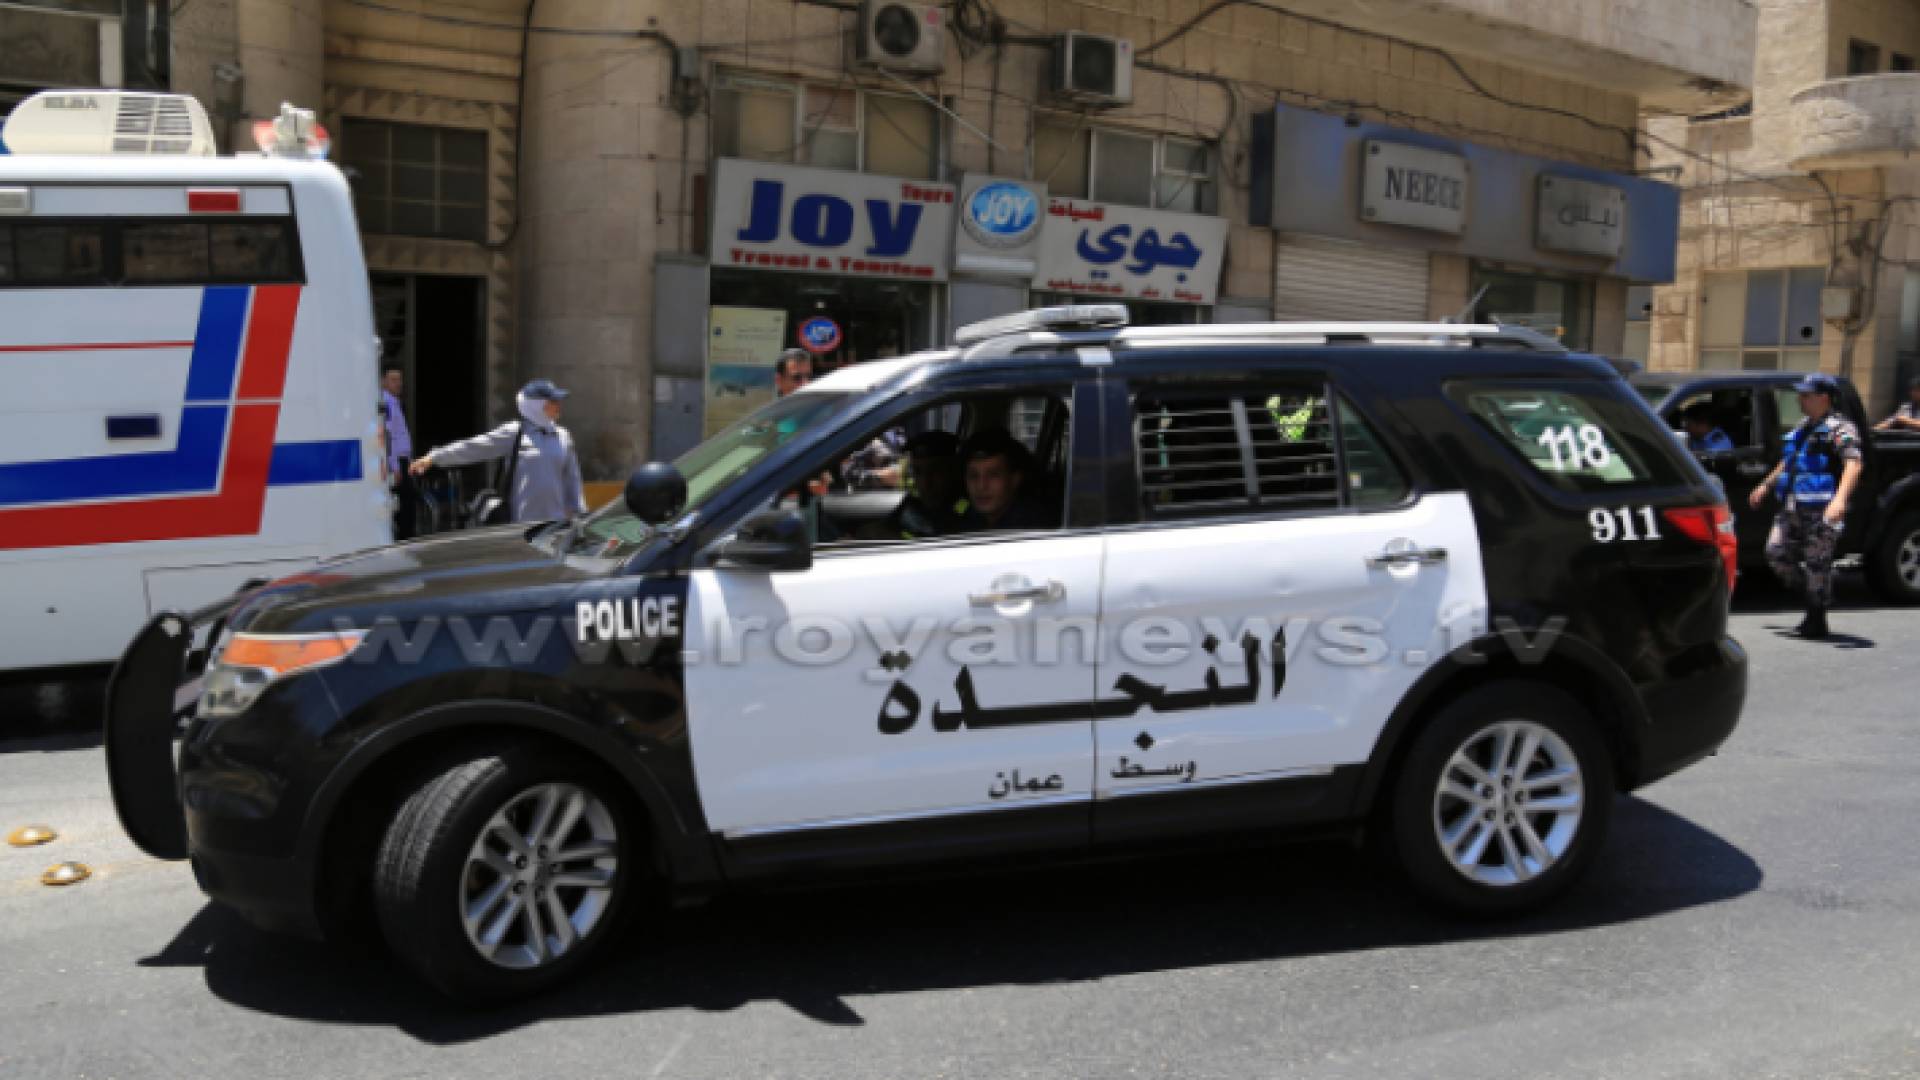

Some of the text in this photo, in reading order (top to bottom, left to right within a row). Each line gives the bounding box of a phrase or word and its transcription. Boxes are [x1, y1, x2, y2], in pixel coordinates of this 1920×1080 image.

[979, 192, 1031, 226] JOY
[1384, 166, 1466, 212] NEECE
[730, 247, 811, 269] Travel
[839, 256, 935, 278] Tourism
[1075, 223, 1203, 284] جوي
[1538, 424, 1610, 471] 118
[1588, 504, 1663, 543] 911
[576, 596, 679, 642] POLICE
[876, 625, 1286, 751] النجدة
[988, 756, 1197, 799] وسط عمان
